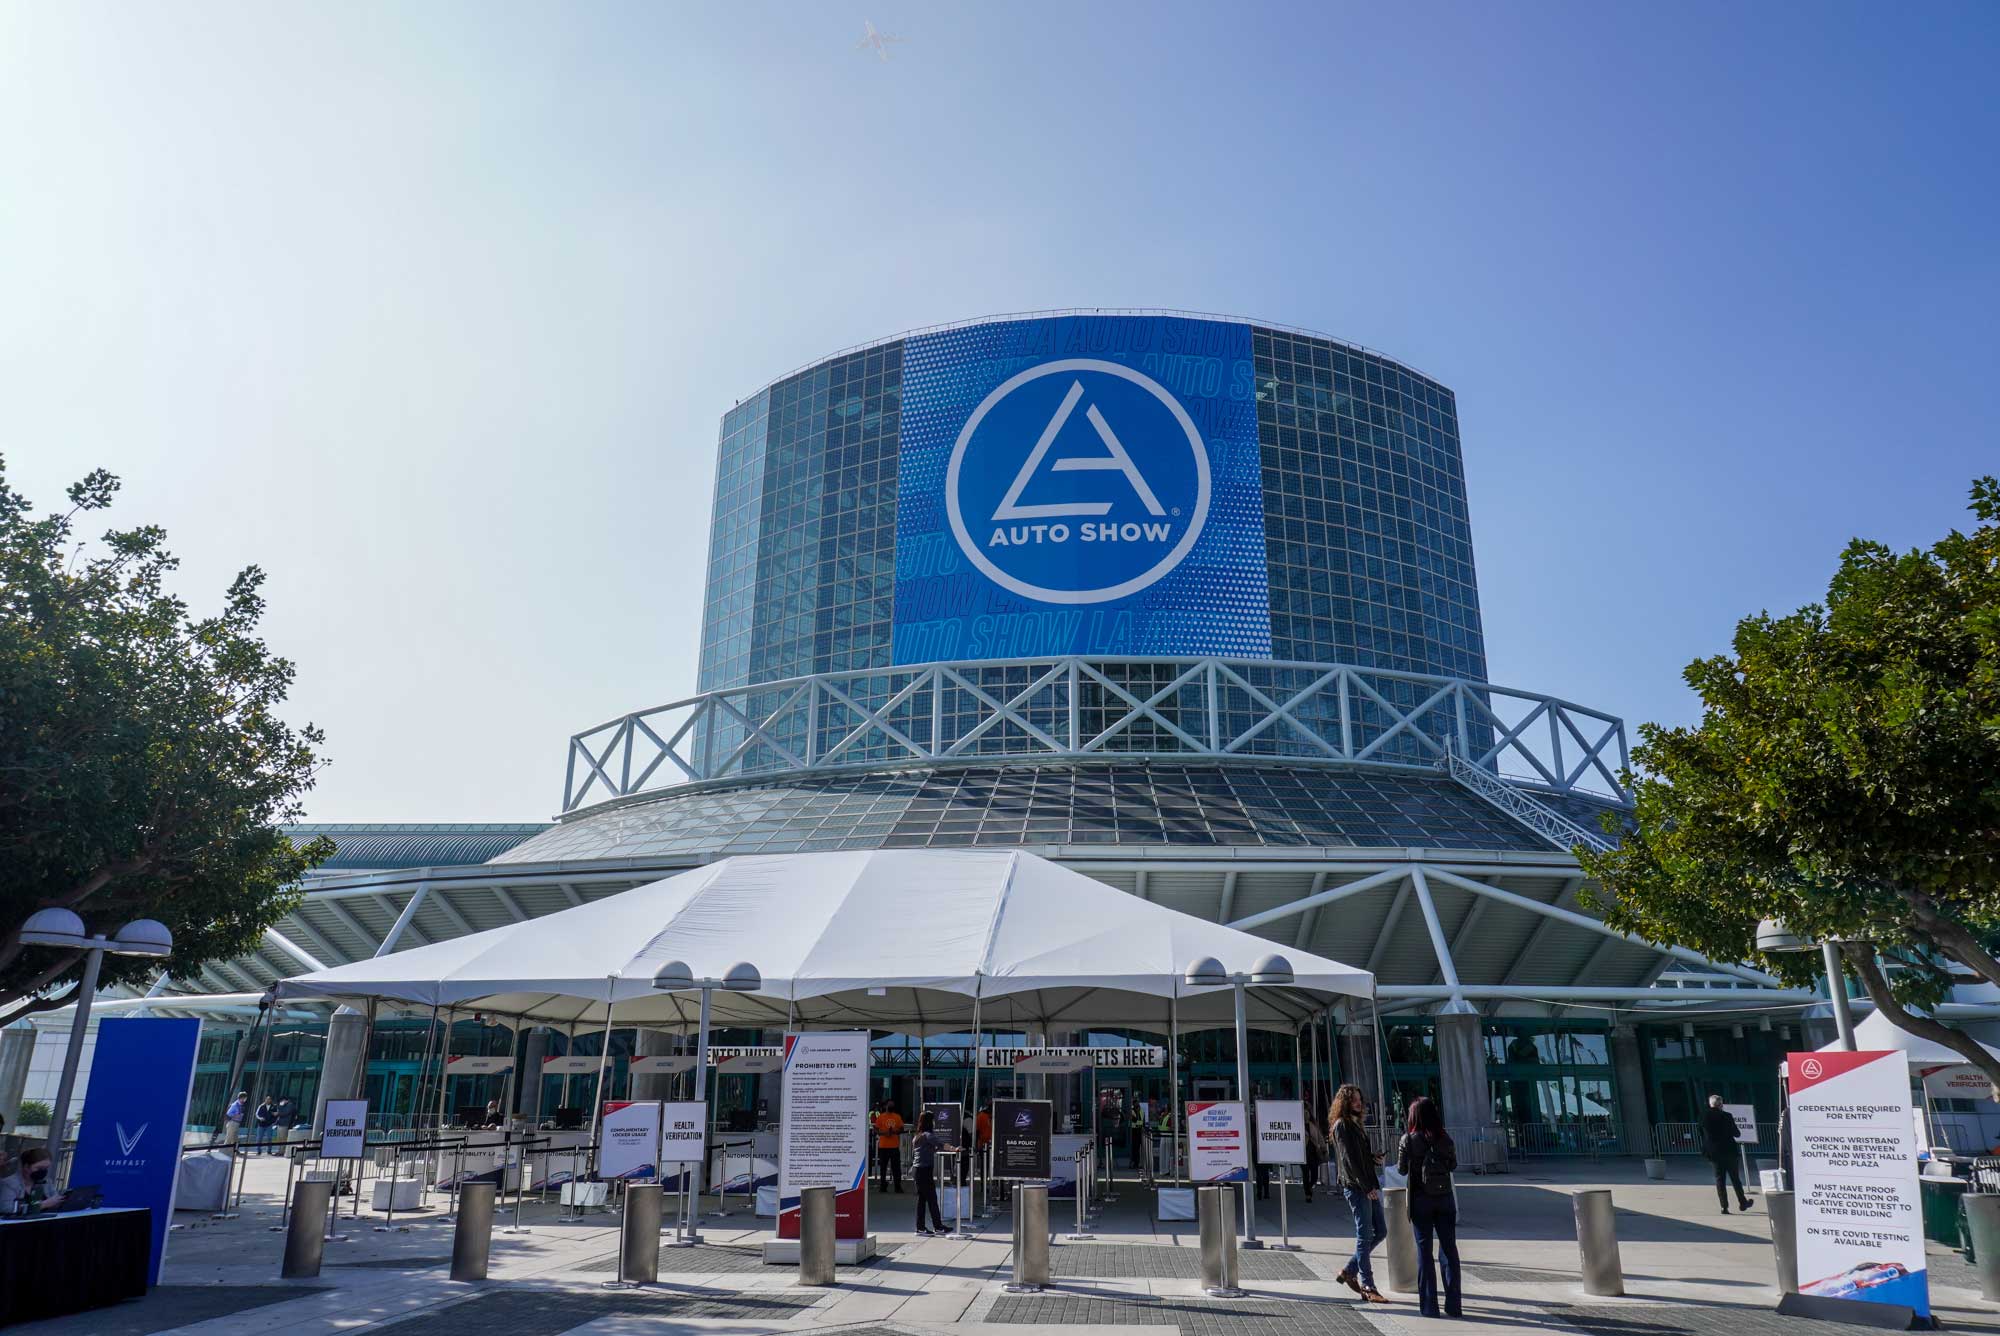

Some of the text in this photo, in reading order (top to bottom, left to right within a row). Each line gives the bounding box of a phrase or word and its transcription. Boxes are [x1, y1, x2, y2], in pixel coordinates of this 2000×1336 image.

[989, 523, 1171, 547] AUTO SHOW
[1123, 1048, 1155, 1066] HERE
[335, 1119, 356, 1127] HEALTH
[674, 1121, 695, 1130] HEALTH
[1269, 1121, 1292, 1130] HEALTH
[326, 1129, 362, 1137] VERIFICATION
[665, 1132, 702, 1140] VERIFICATION
[1261, 1132, 1301, 1141] VERIFICATION
[1825, 1192, 1884, 1201] VACCINATION
[1802, 1199, 1844, 1207] NEGATIVE
[1851, 1209, 1893, 1218] BUILDING
[1842, 1231, 1869, 1239] COVID
[1872, 1233, 1910, 1241] TESTING
[1834, 1238, 1882, 1248] AVAILABLE
